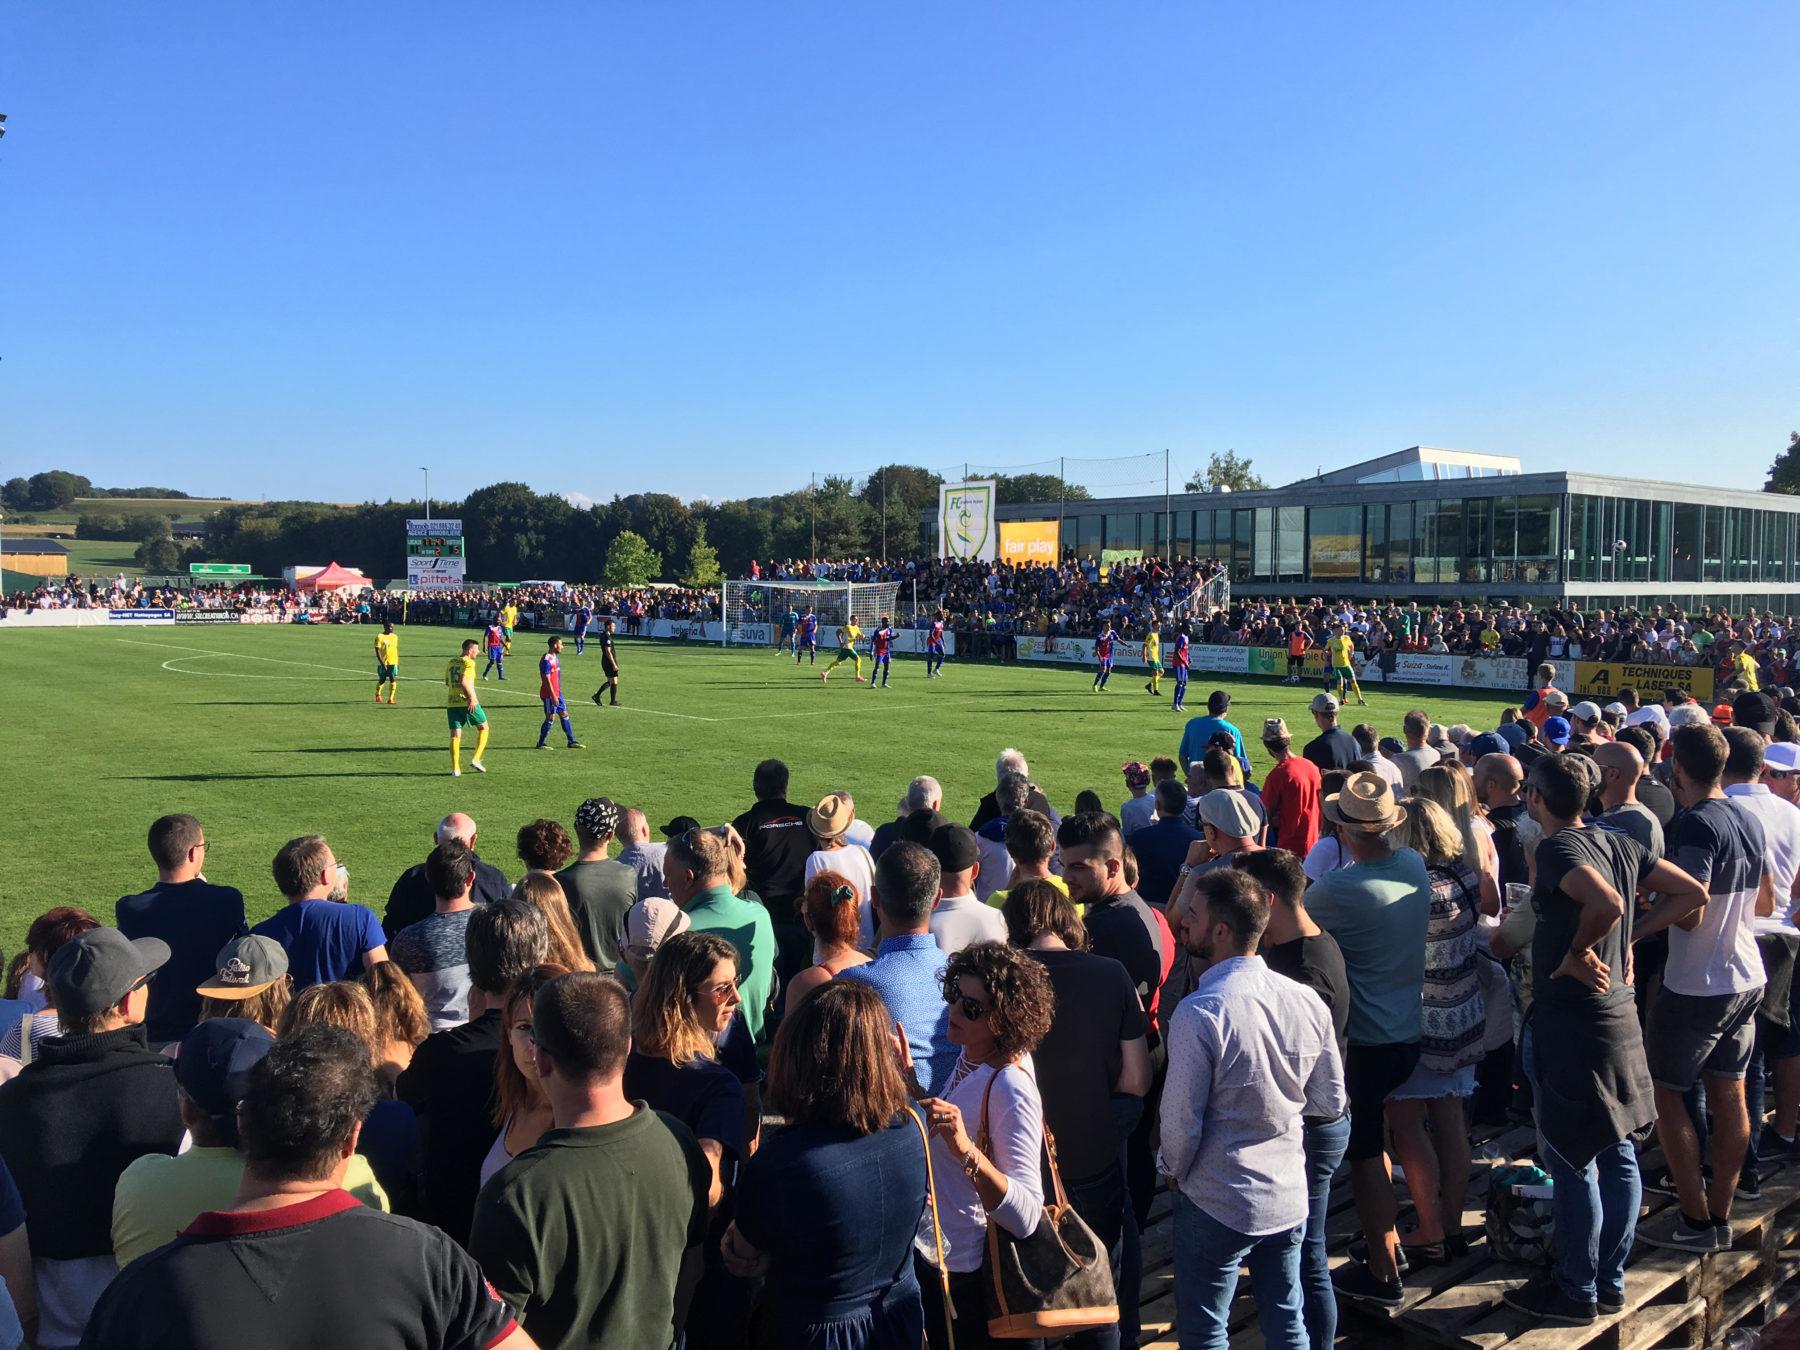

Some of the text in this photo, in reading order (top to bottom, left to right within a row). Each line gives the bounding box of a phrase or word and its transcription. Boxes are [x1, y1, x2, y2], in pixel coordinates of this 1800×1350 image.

[950, 496, 962, 510] FC
[1005, 539, 1054, 555] fair play
[410, 559, 460, 567] Sport Time
[671, 624, 698, 636] helvetia
[740, 628, 765, 641] suva
[1217, 655, 1244, 663] ventilation
[1258, 649, 1283, 660] Union
[1402, 660, 1422, 669] Suiza
[1589, 669, 1609, 684] A
[1622, 666, 1693, 680] TECHNIQUES
[1678, 682, 1692, 692] SA
